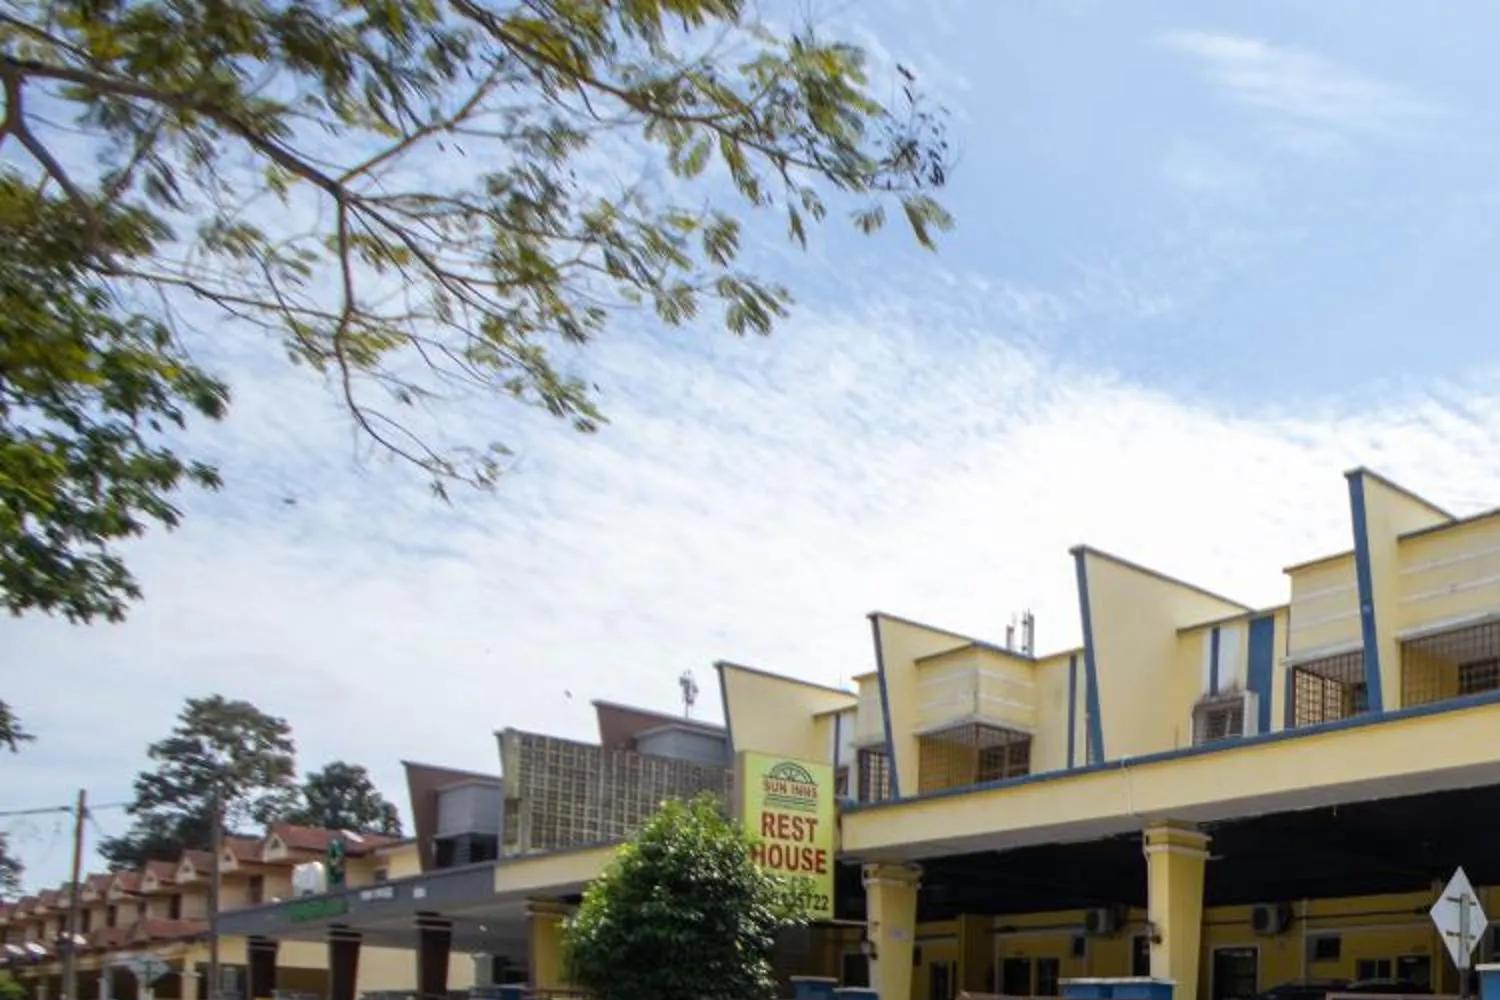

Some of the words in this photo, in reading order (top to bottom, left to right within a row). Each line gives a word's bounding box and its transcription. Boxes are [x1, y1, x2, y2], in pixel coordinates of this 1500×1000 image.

[764, 777, 787, 794] SUN
[791, 783, 818, 799] INNS
[761, 811, 818, 843] REST
[750, 842, 828, 875] HOUSE
